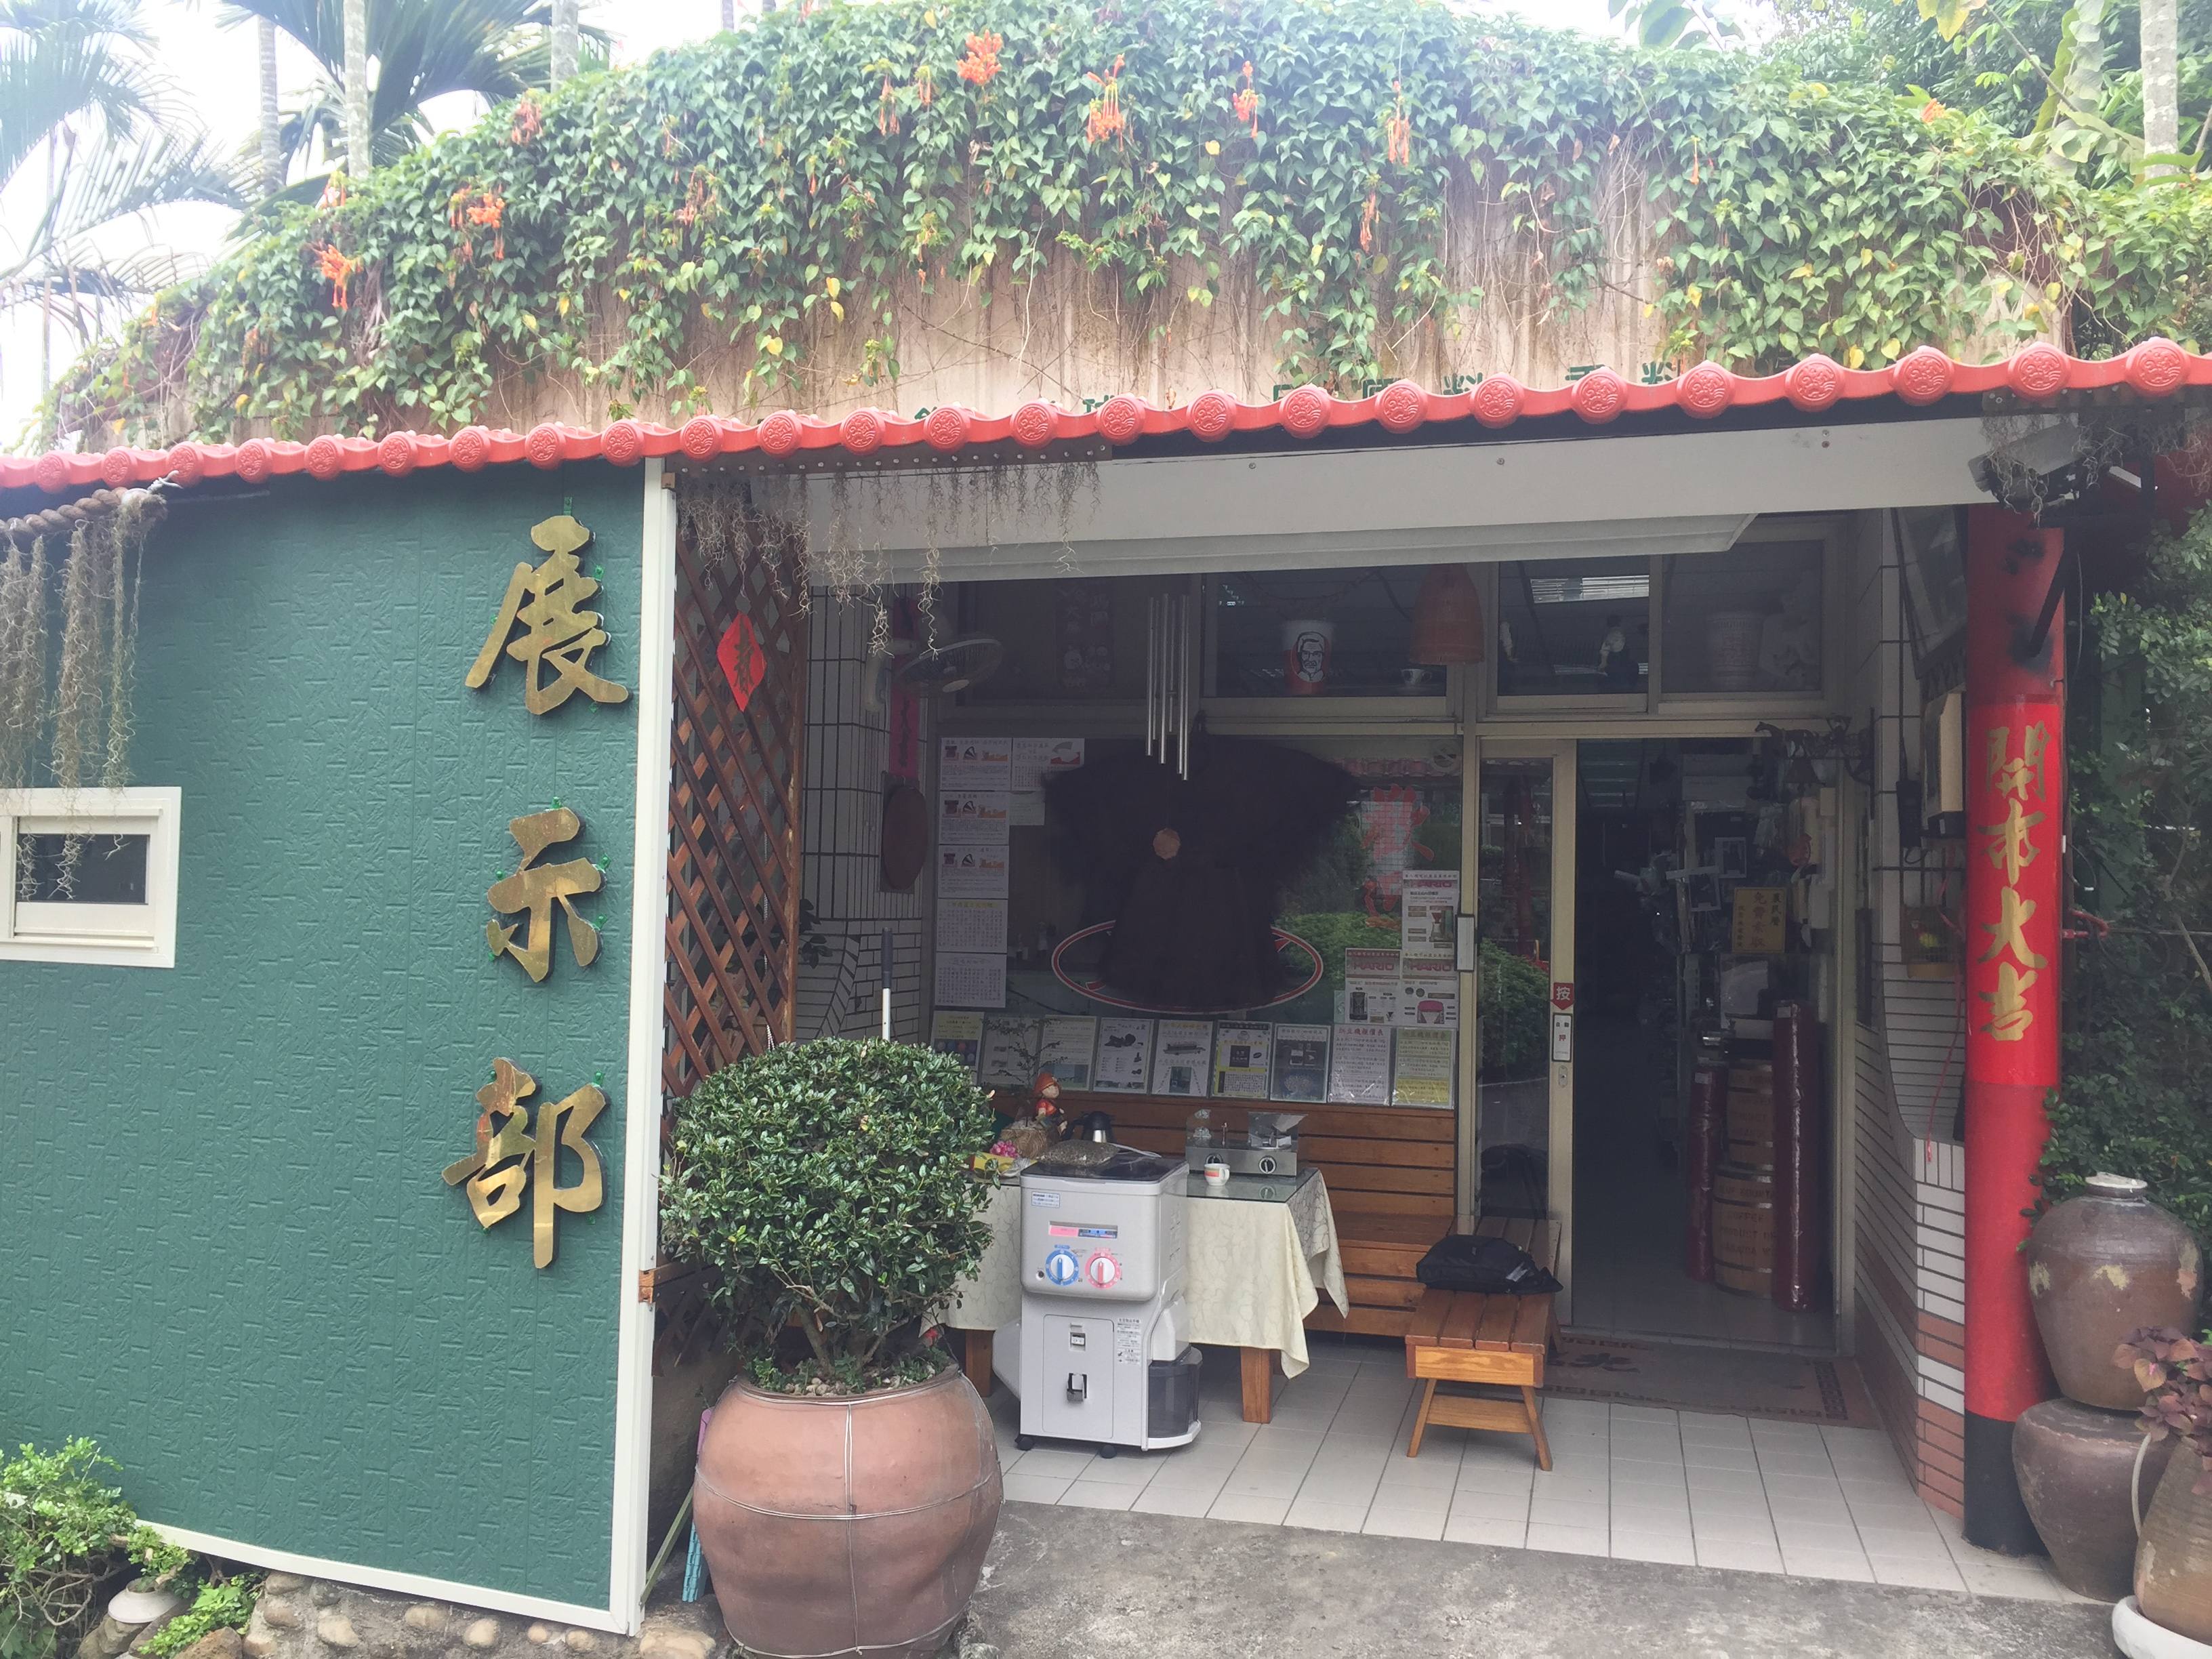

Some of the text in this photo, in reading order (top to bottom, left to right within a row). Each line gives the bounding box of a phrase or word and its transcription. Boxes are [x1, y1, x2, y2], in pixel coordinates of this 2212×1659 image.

[442, 515, 630, 1269] 展示部
[1555, 986, 1571, 1001] 按
[1978, 719, 2049, 1042] 開市大吉
